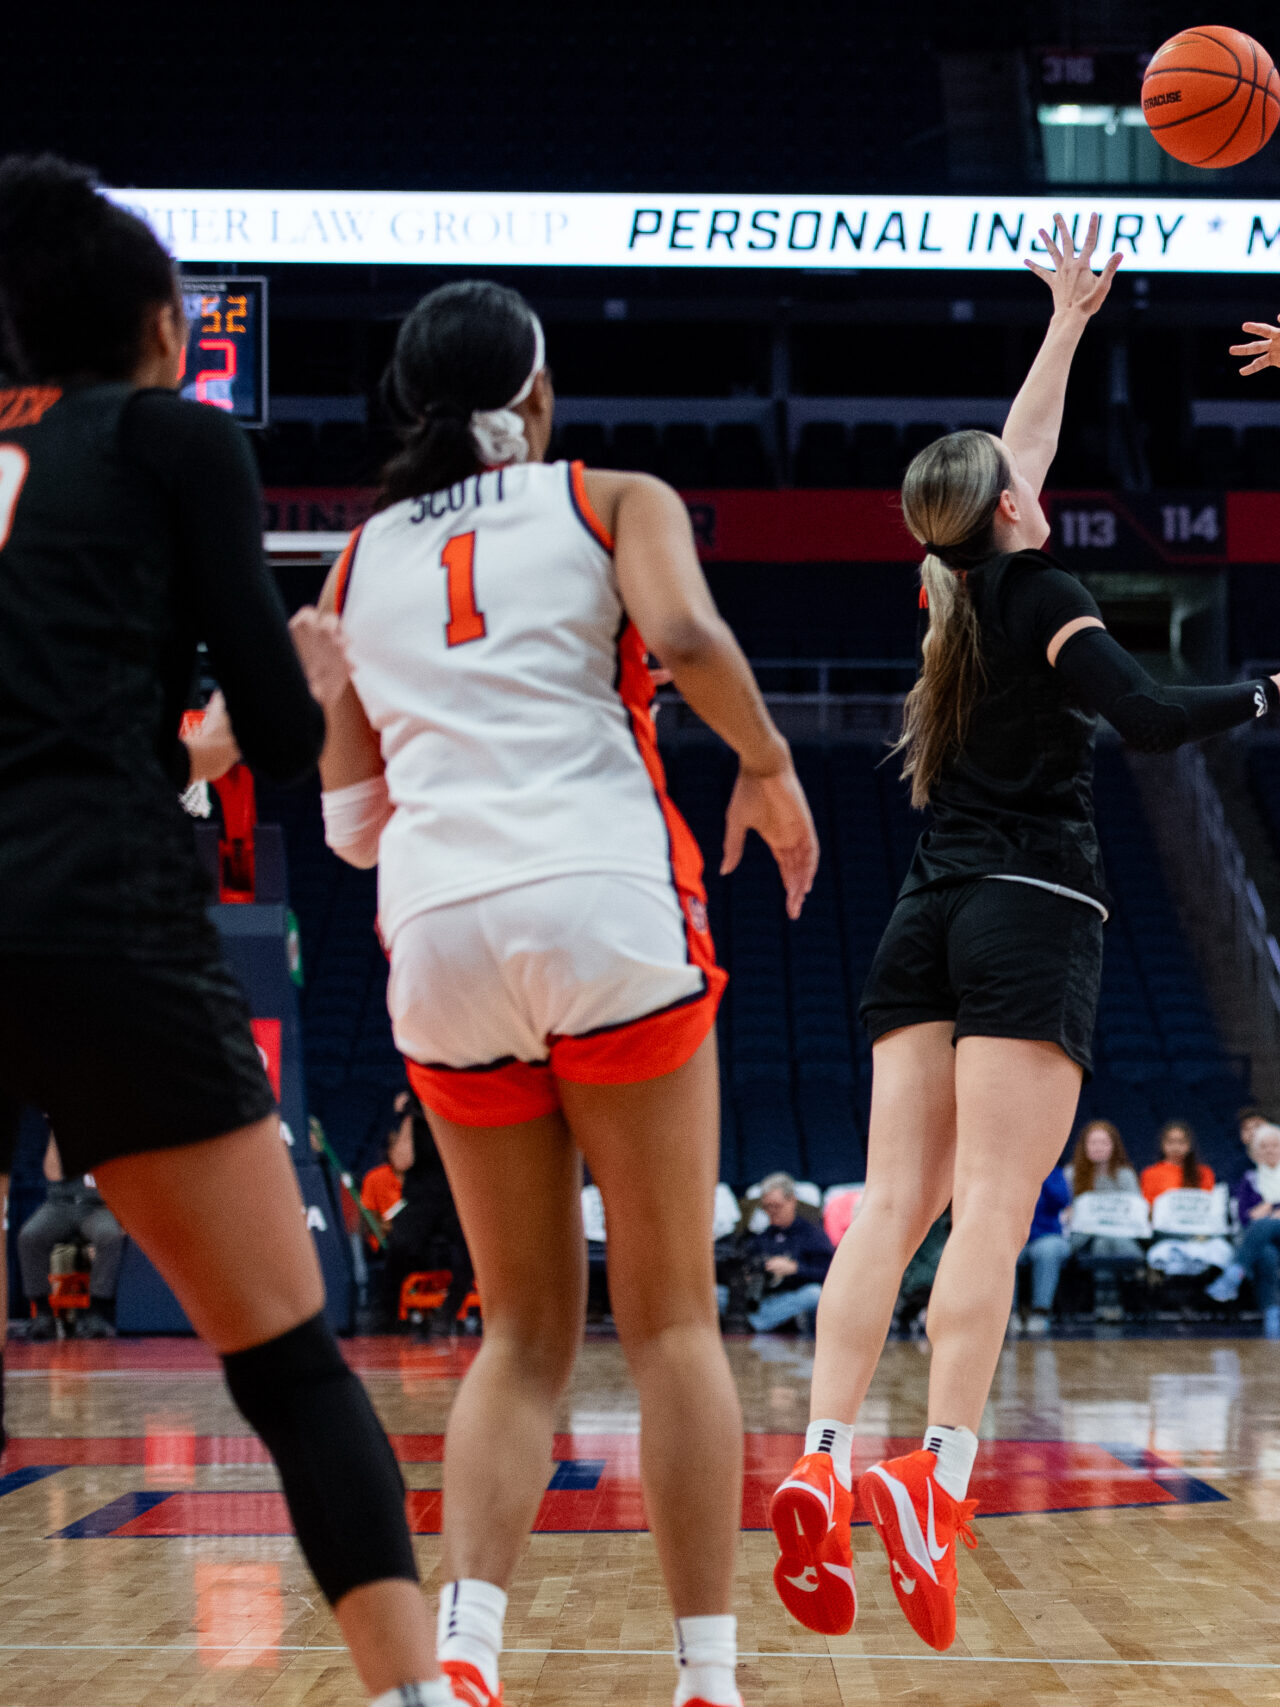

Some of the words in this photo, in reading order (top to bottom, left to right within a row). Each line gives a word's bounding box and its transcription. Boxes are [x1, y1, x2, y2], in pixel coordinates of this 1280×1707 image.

[271, 208, 374, 246] LAW
[389, 209, 570, 247] GROUP
[627, 208, 943, 253] PERSONAL
[967, 212, 1185, 255] INJURY
[1060, 510, 1117, 547] 113
[1161, 505, 1219, 543] 114
[440, 530, 487, 648] 1
